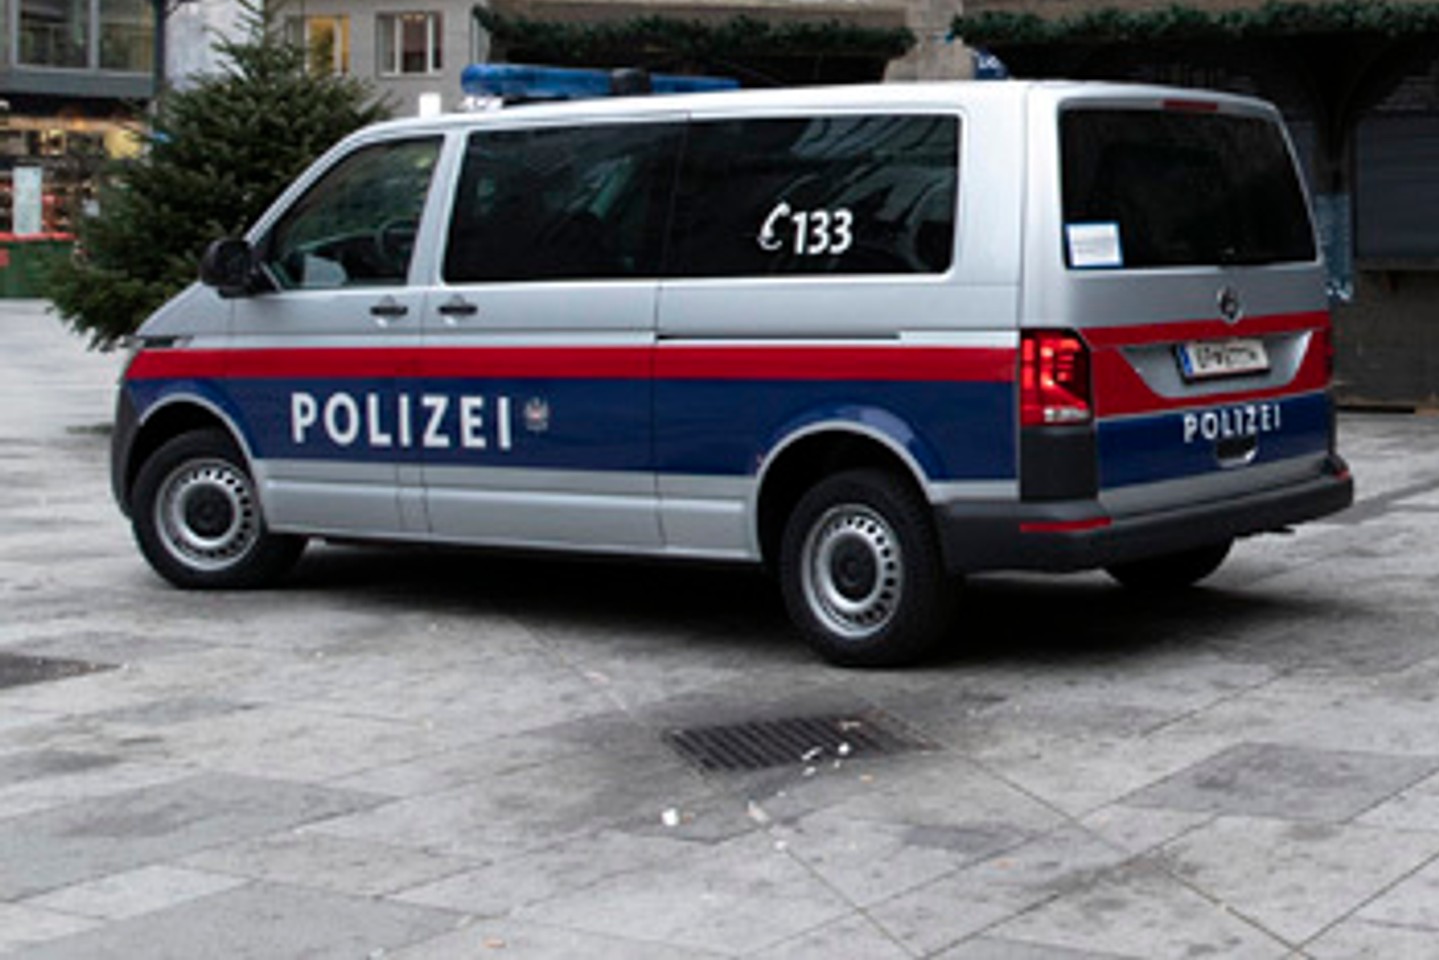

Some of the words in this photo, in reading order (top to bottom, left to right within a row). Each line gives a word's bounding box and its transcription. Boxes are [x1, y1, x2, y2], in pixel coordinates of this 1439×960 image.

[791, 208, 853, 255] 133
[290, 391, 512, 450] POLIZEI
[1184, 402, 1281, 444] POLIZEI
